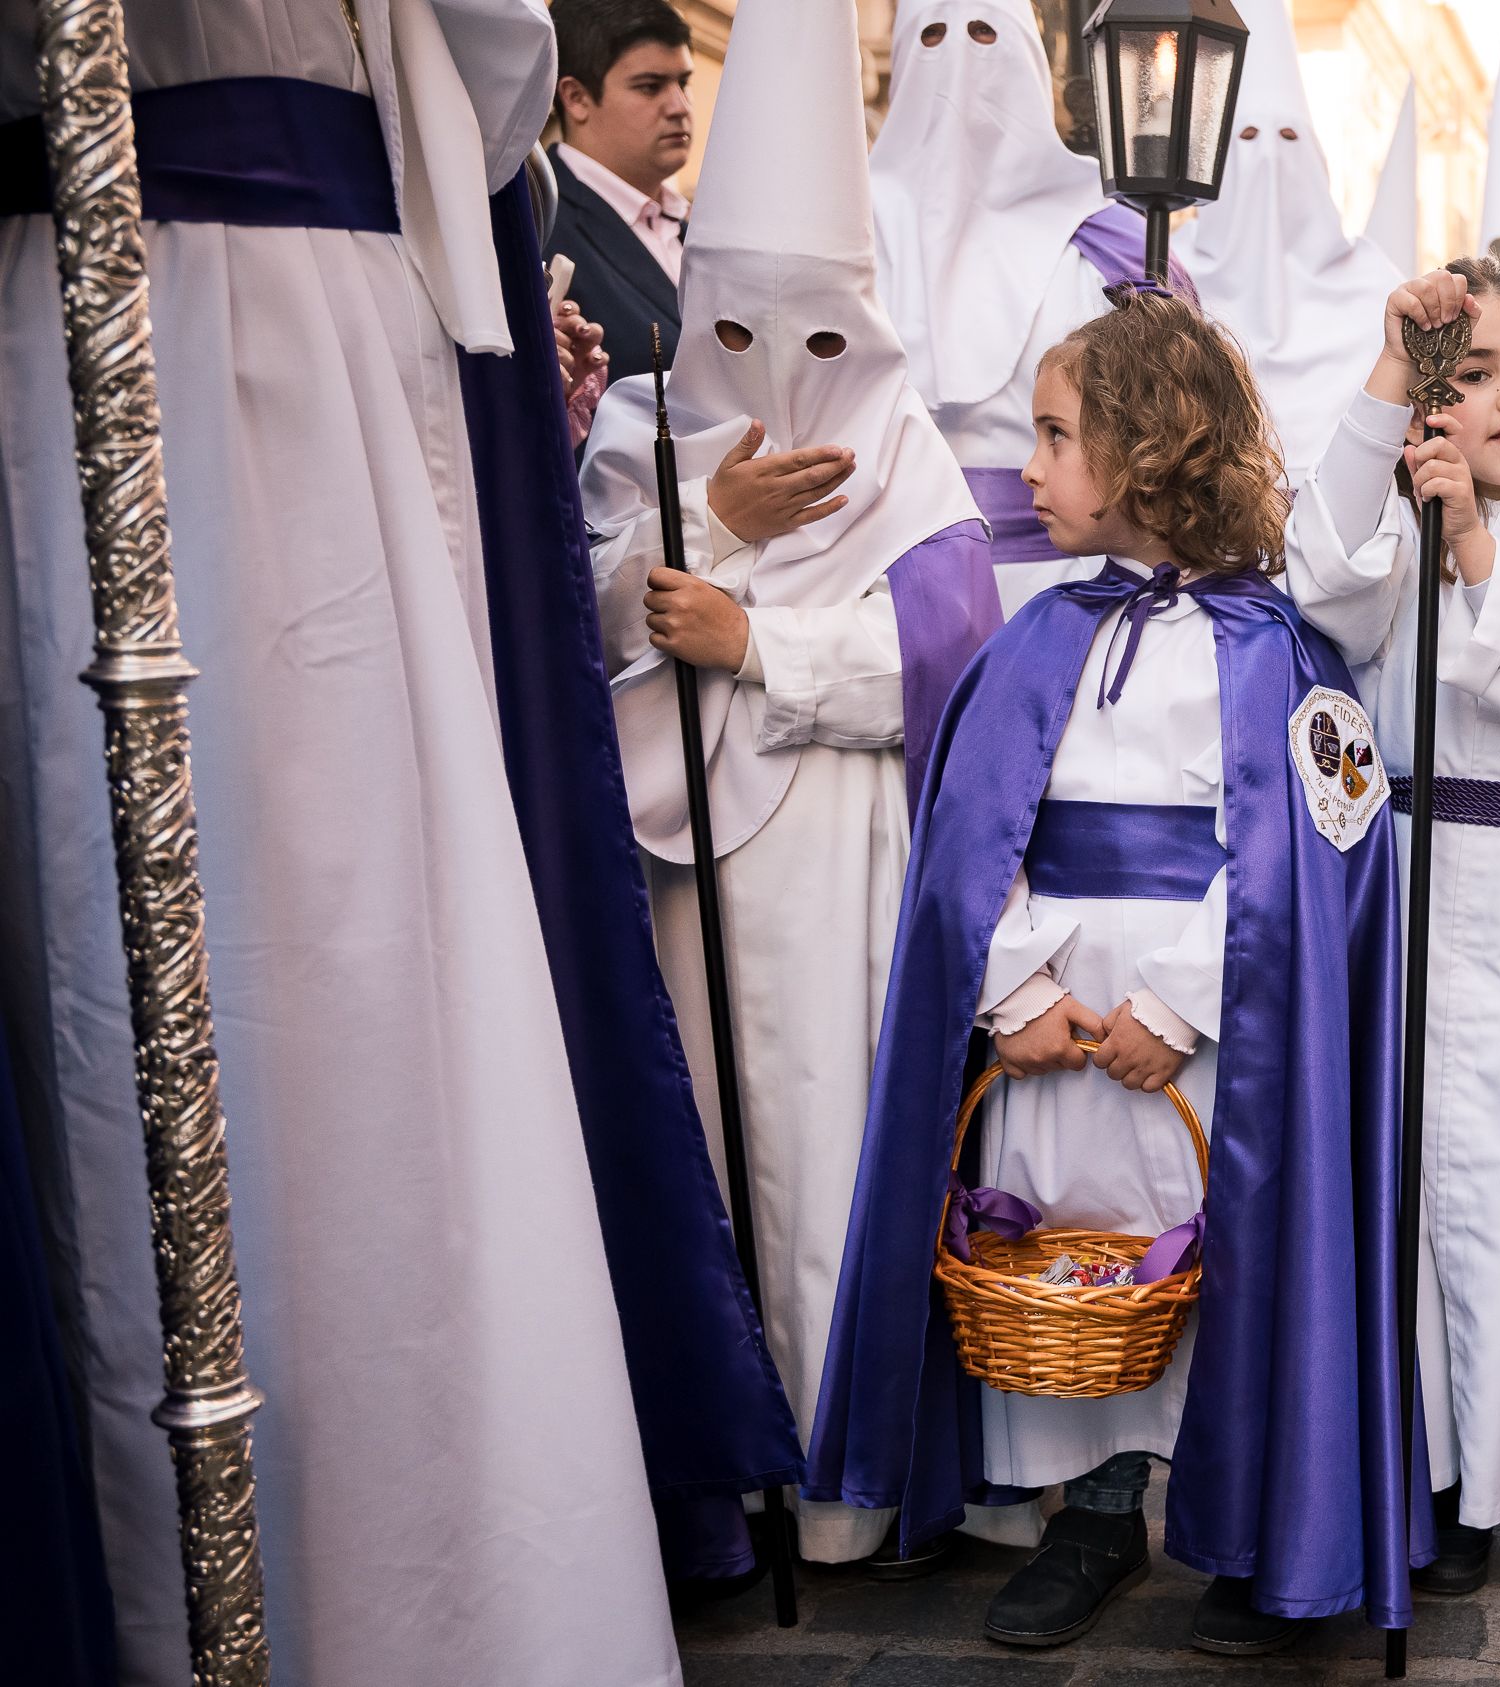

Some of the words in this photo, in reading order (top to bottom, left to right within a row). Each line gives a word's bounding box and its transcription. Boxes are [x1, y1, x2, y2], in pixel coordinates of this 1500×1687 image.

[1333, 704, 1364, 735] FIDES
[1316, 774, 1324, 788] TU
[1324, 789, 1332, 800] ES
[1332, 796, 1354, 812] PETRUS
